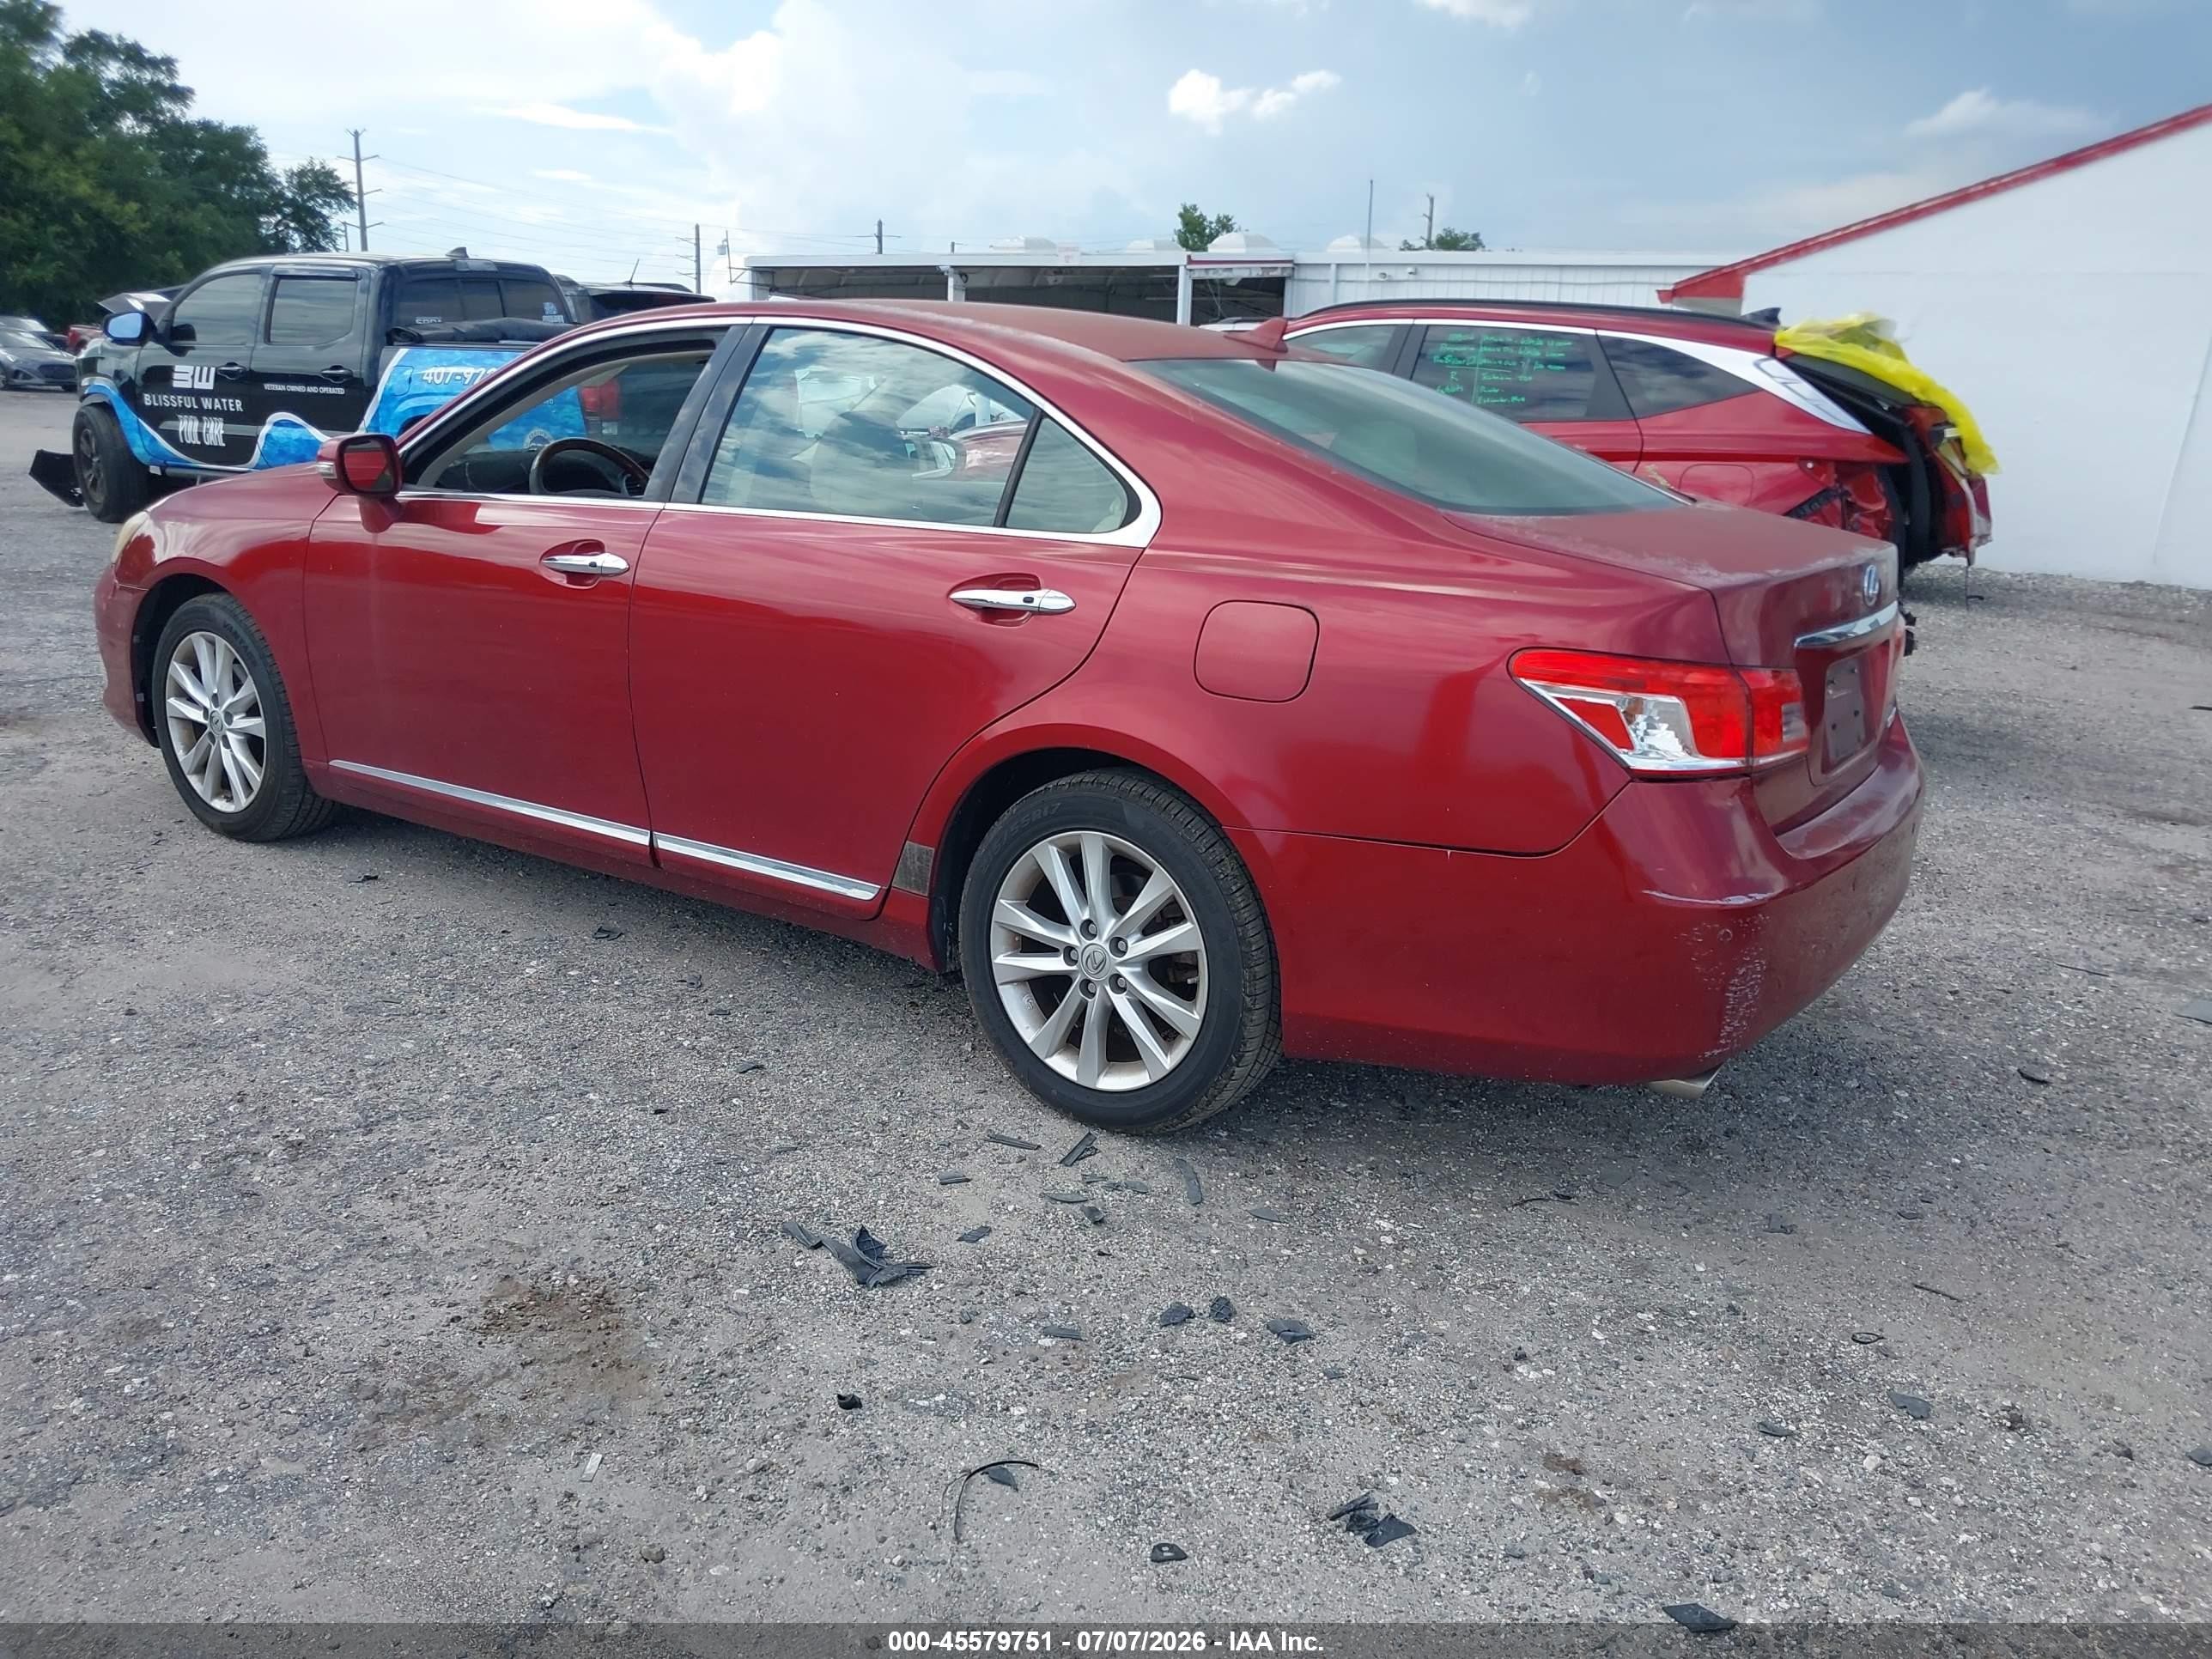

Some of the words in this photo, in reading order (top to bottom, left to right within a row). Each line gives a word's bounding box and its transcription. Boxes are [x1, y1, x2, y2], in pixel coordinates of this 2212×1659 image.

[264, 383, 286, 392] VETERAN
[319, 386, 345, 395] OPERATED
[143, 393, 198, 409] BLISSFUL
[200, 397, 244, 412] WATER
[177, 415, 201, 445] POOL
[203, 416, 226, 447] CARE
